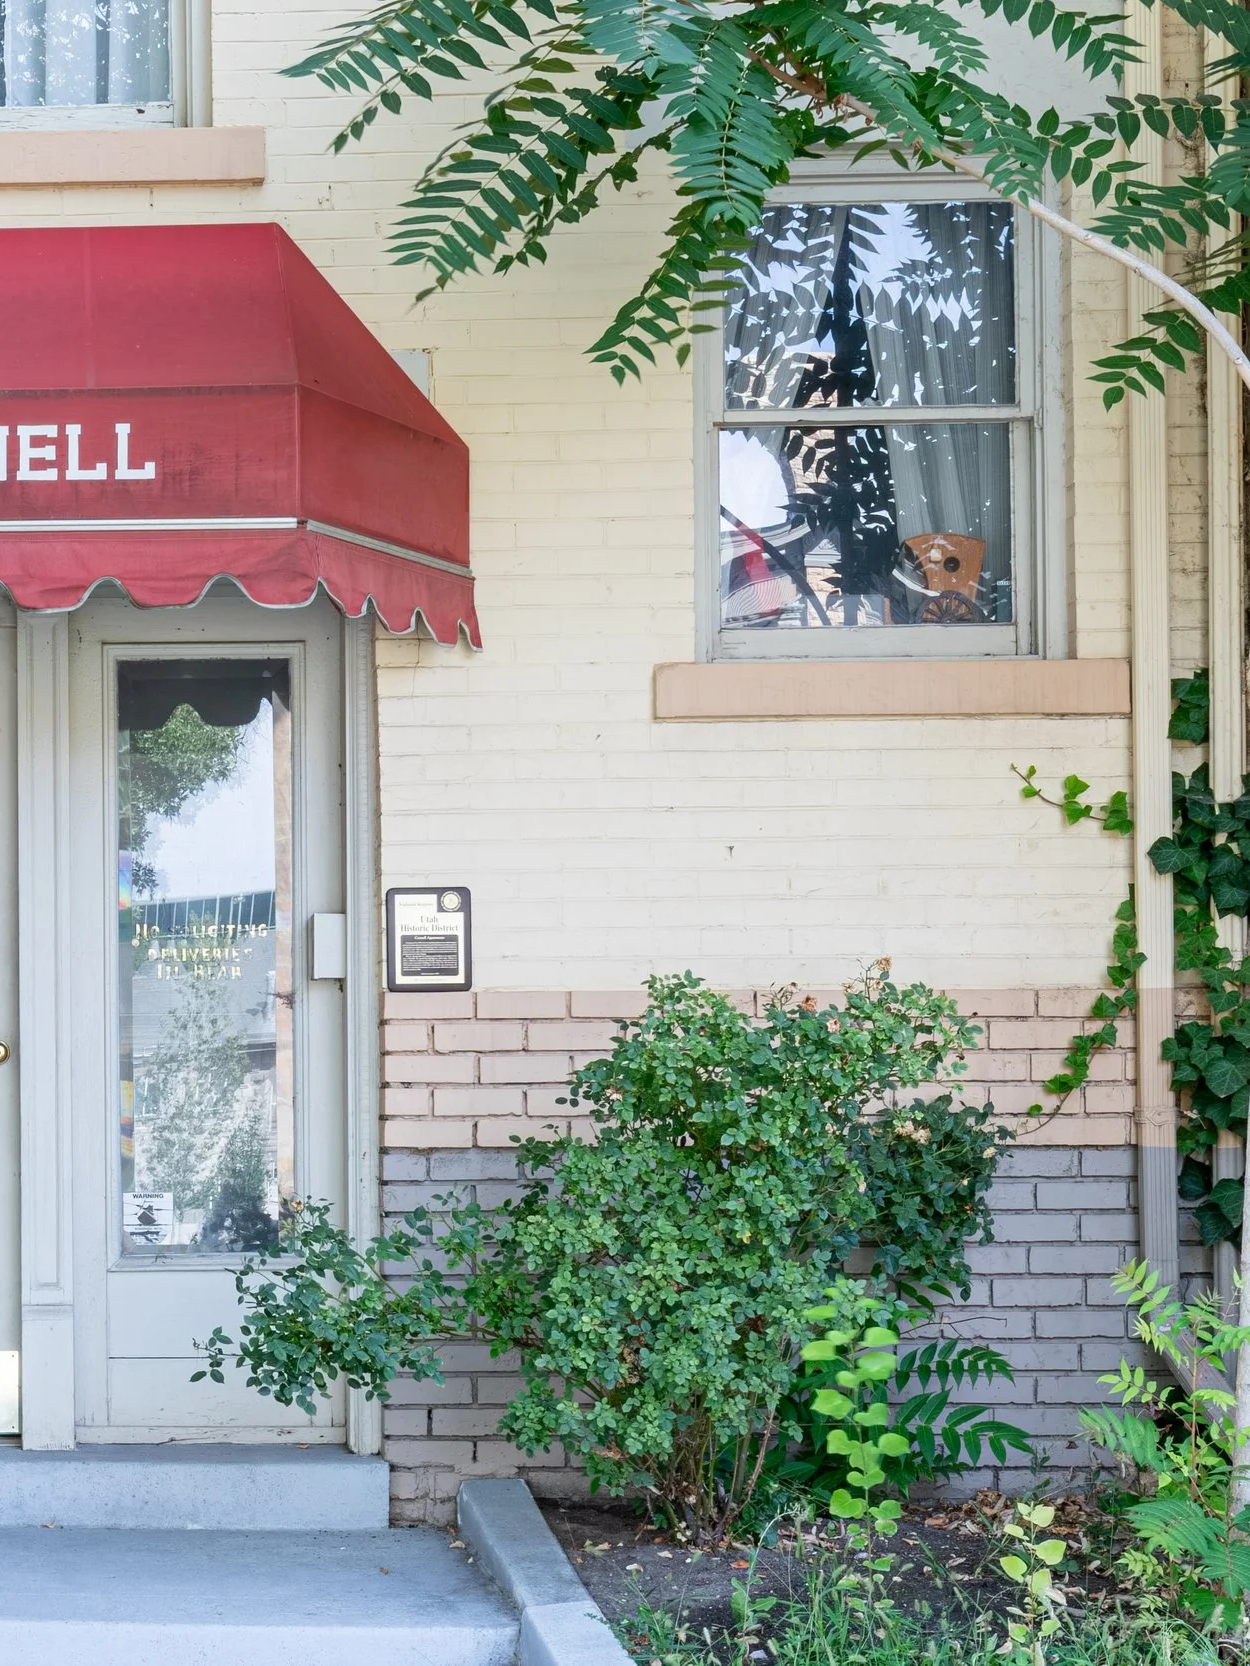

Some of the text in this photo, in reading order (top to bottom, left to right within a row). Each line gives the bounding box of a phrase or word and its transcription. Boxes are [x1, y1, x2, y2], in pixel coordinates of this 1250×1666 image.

[420, 915, 439, 923] Utah
[135, 923, 268, 940] NO SOLICITING
[400, 924, 459, 932] Historic District
[148, 948, 253, 962] DELIVERIES
[157, 964, 179, 980] IN
